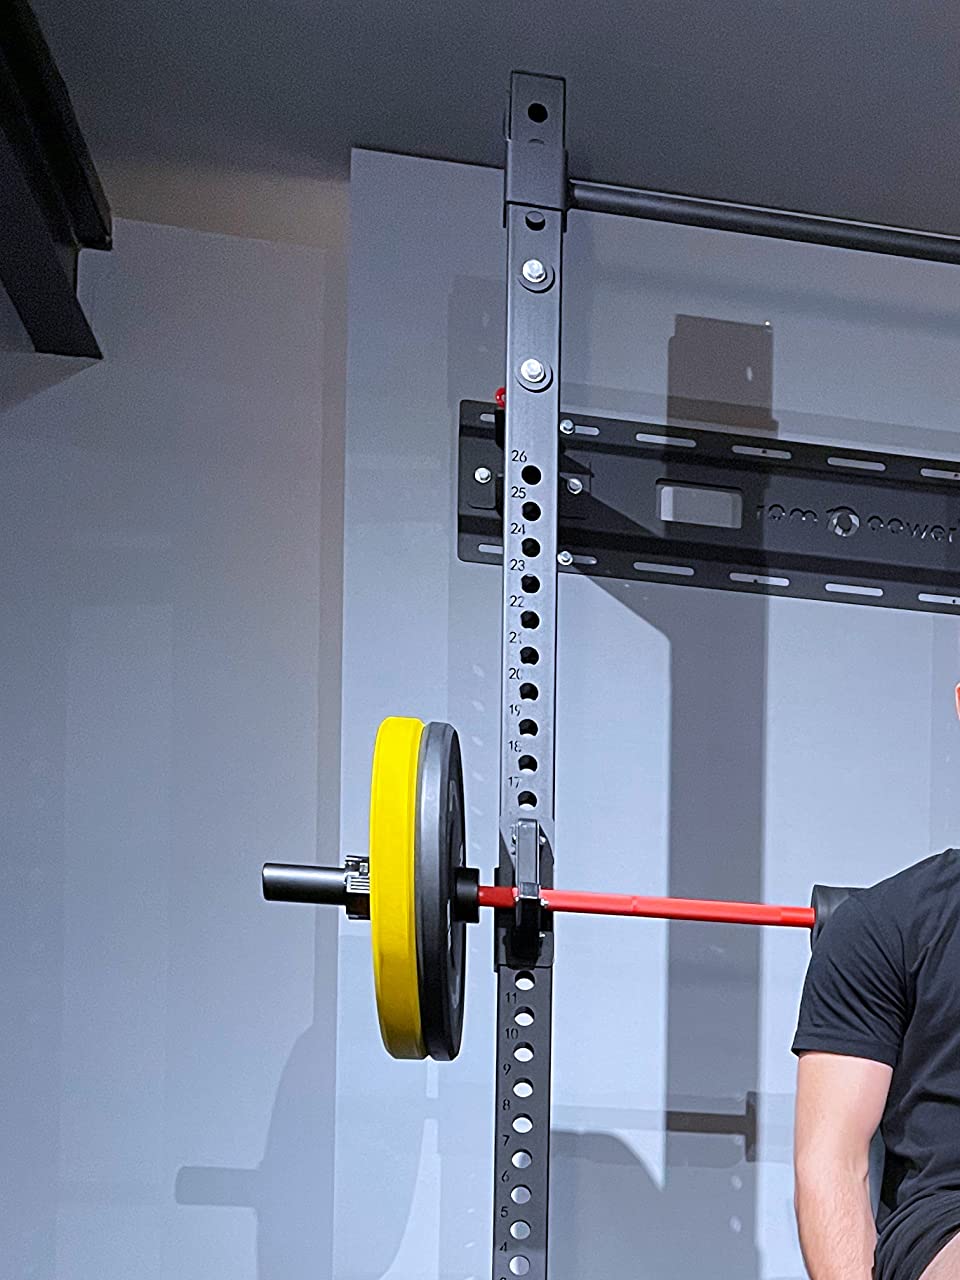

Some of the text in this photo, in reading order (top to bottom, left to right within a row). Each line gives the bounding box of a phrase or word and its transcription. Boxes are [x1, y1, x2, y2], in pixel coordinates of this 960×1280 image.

[511, 449, 528, 463] 26
[511, 486, 527, 499] 25
[510, 522, 526, 535] 24
[509, 558, 526, 571] 23
[509, 595, 525, 608] 22
[507, 776, 522, 788] 17
[504, 991, 518, 1005] 11
[504, 1027, 519, 1040] 10
[502, 1063, 512, 1075] 9
[502, 1099, 511, 1112] 8
[502, 1134, 511, 1147] 7
[501, 1170, 510, 1183] 6
[500, 1206, 509, 1218] 5
[499, 1241, 508, 1253] 4
